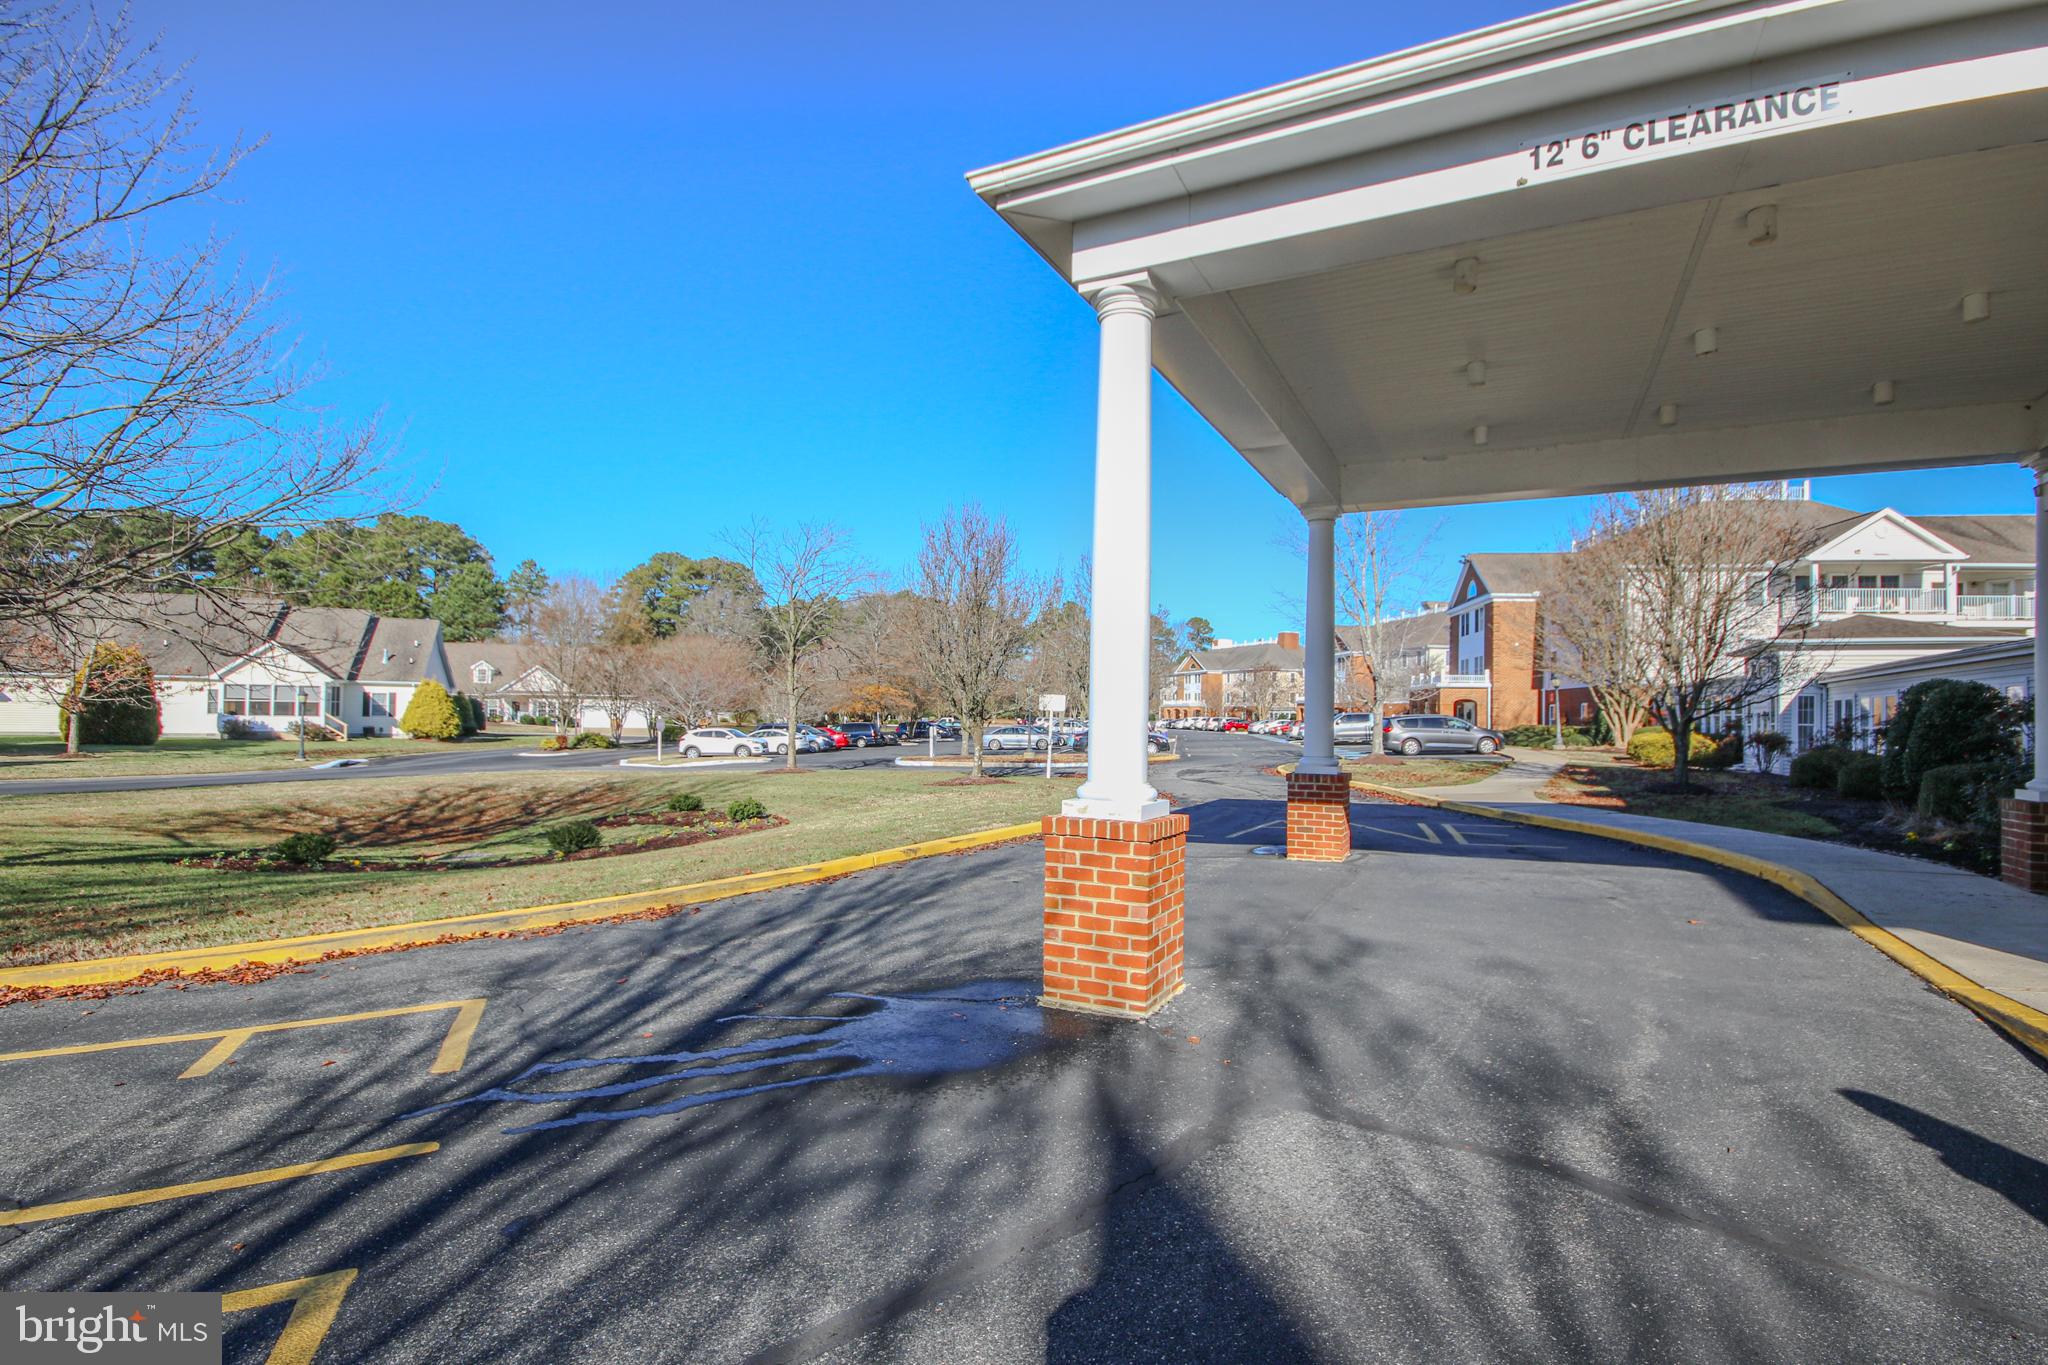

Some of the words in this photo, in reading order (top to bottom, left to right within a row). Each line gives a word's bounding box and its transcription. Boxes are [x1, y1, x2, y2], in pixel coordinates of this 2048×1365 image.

[1529, 137, 1570, 170] 12'
[1581, 129, 1611, 160] 6"
[1622, 81, 1841, 150] CLEARANCE
